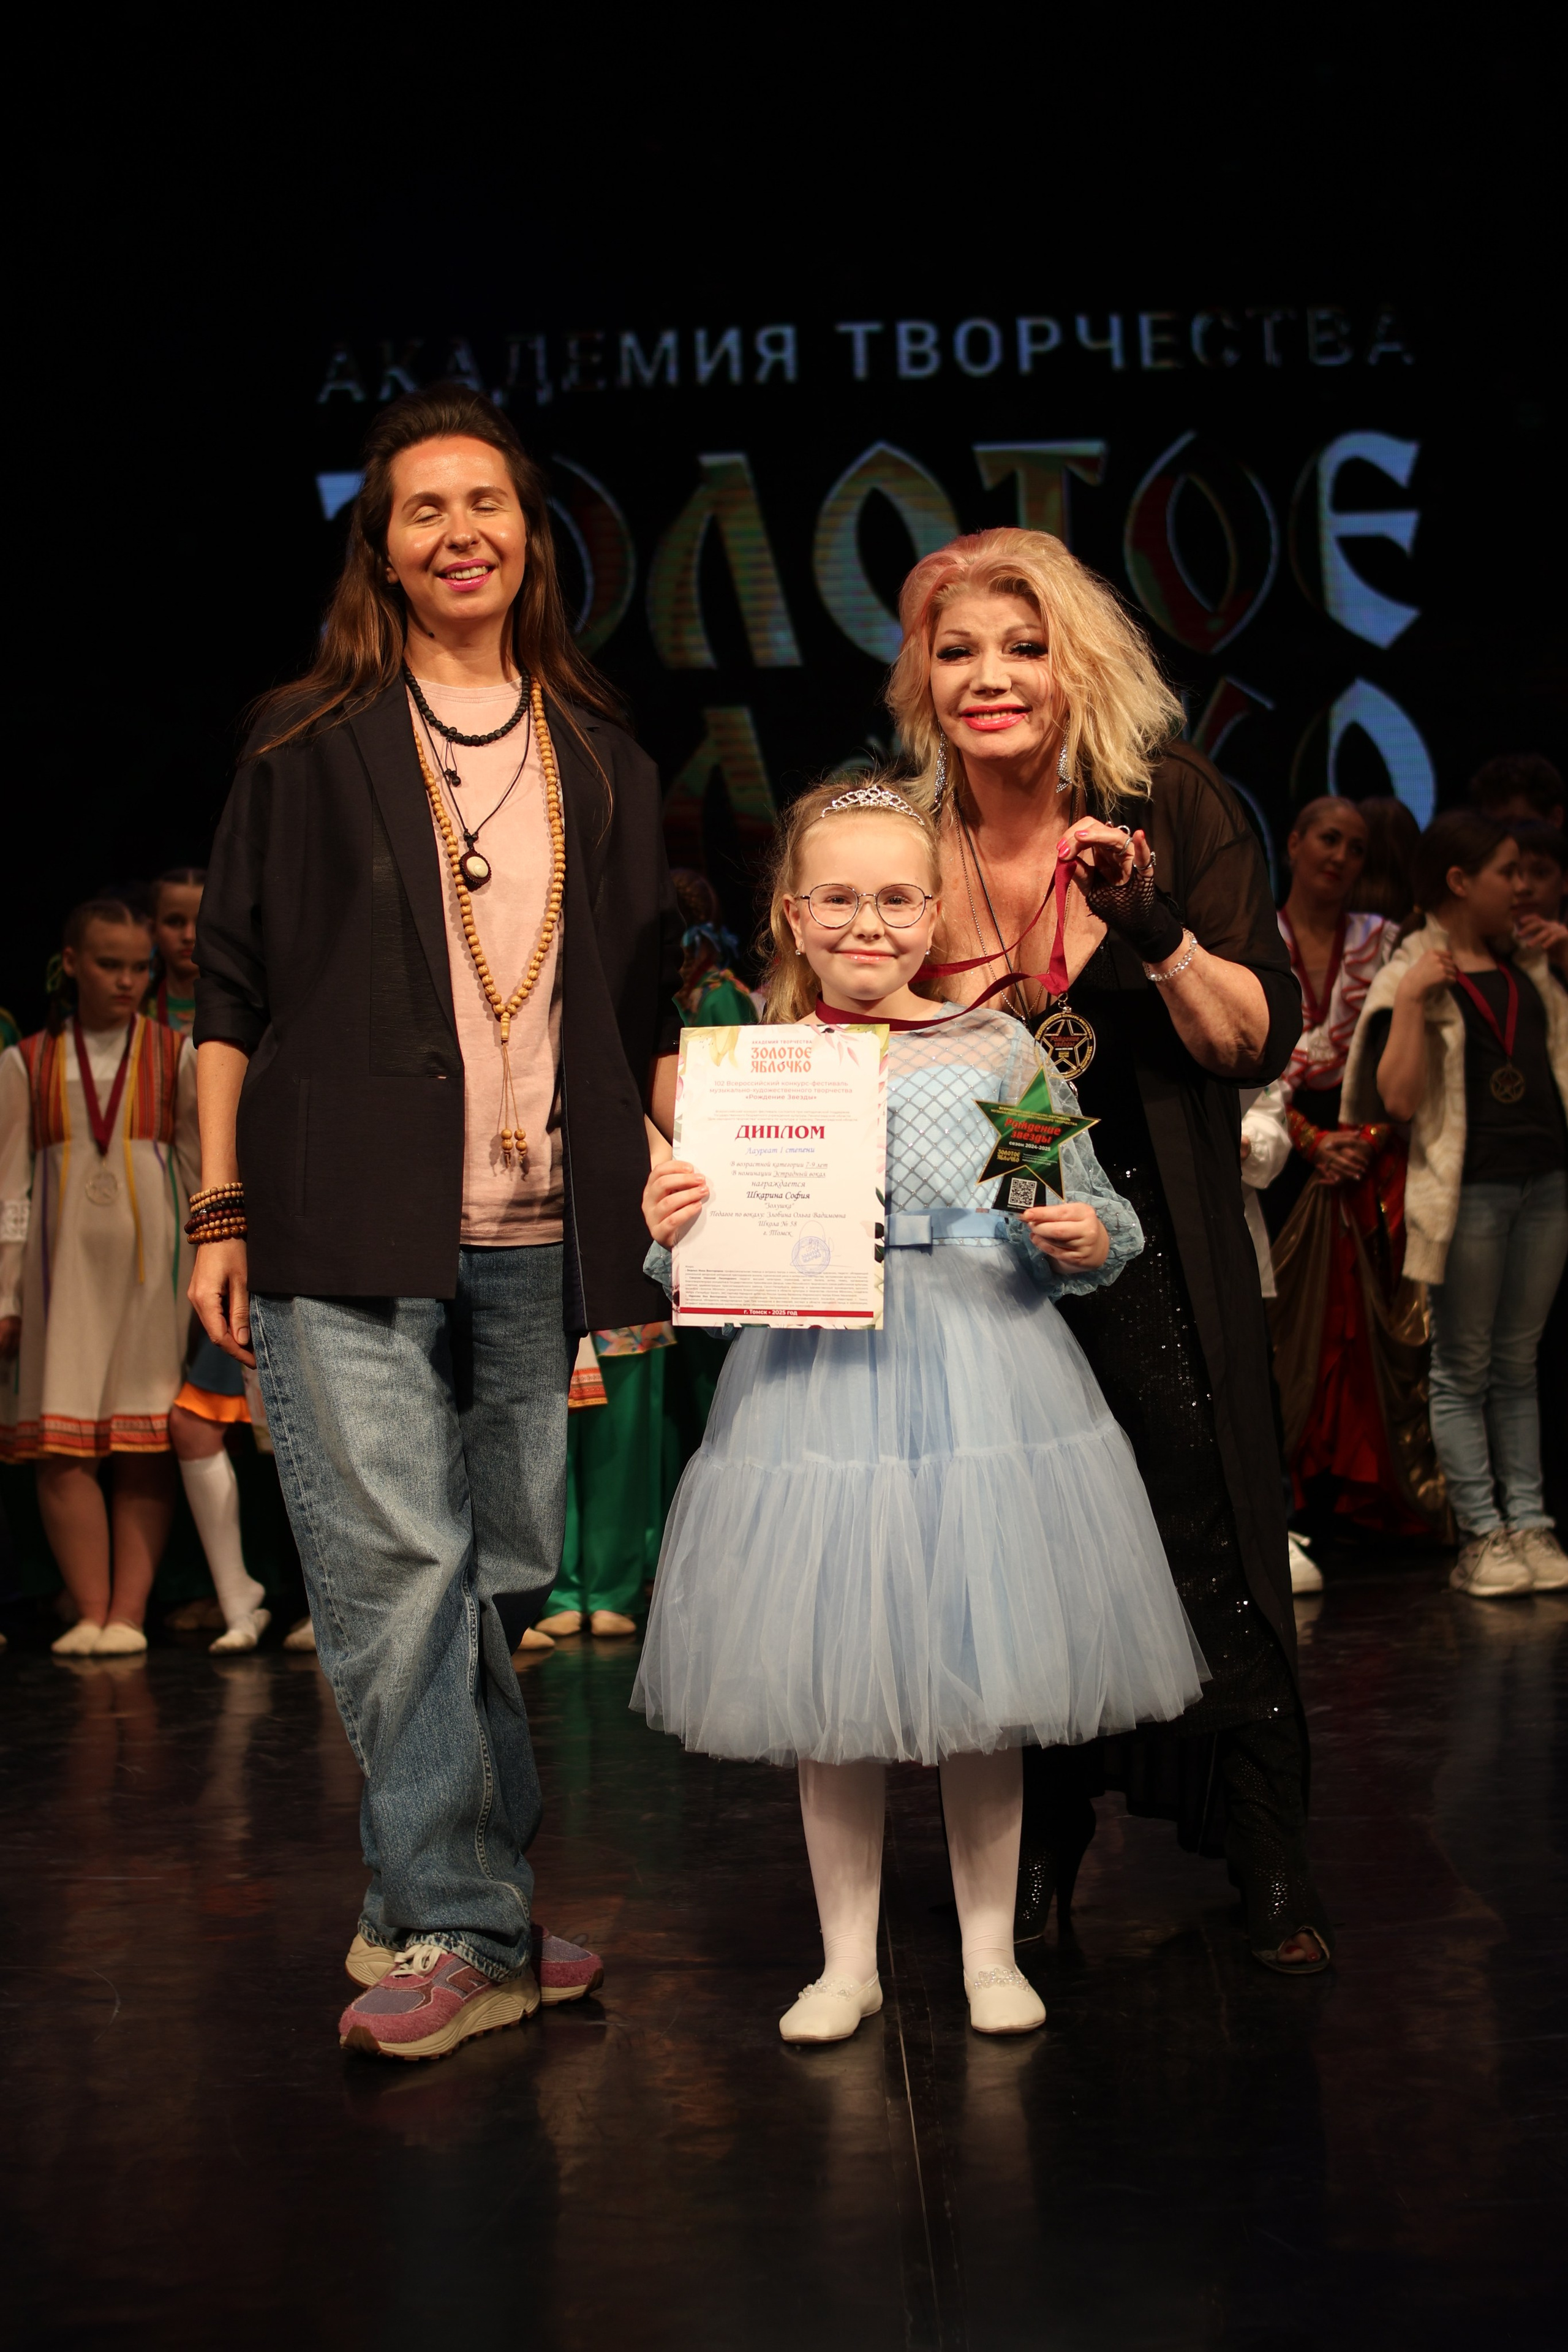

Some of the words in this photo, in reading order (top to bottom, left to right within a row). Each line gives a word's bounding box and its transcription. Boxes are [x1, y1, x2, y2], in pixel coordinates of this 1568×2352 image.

[315, 322, 799, 407] АКАДЕМИЯ
[834, 302, 1416, 382] ТВОРЧЕСТВА
[314, 428, 1425, 669] ОЛОТОЕ
[751, 1047, 812, 1059] ЗОЛОТОЕ
[750, 1060, 812, 1073] ЯБЛОЧКО
[1005, 1117, 1062, 1136] Рождение
[734, 1125, 826, 1142] ДИПЛОМ
[1010, 1129, 1053, 1144] звезды
[745, 1147, 777, 1156] Лауреат
[1025, 1143, 1051, 1152] 2024-2025
[752, 1180, 806, 1189] награждается
[746, 1191, 783, 1200] Шкарина
[785, 1191, 810, 1201] София
